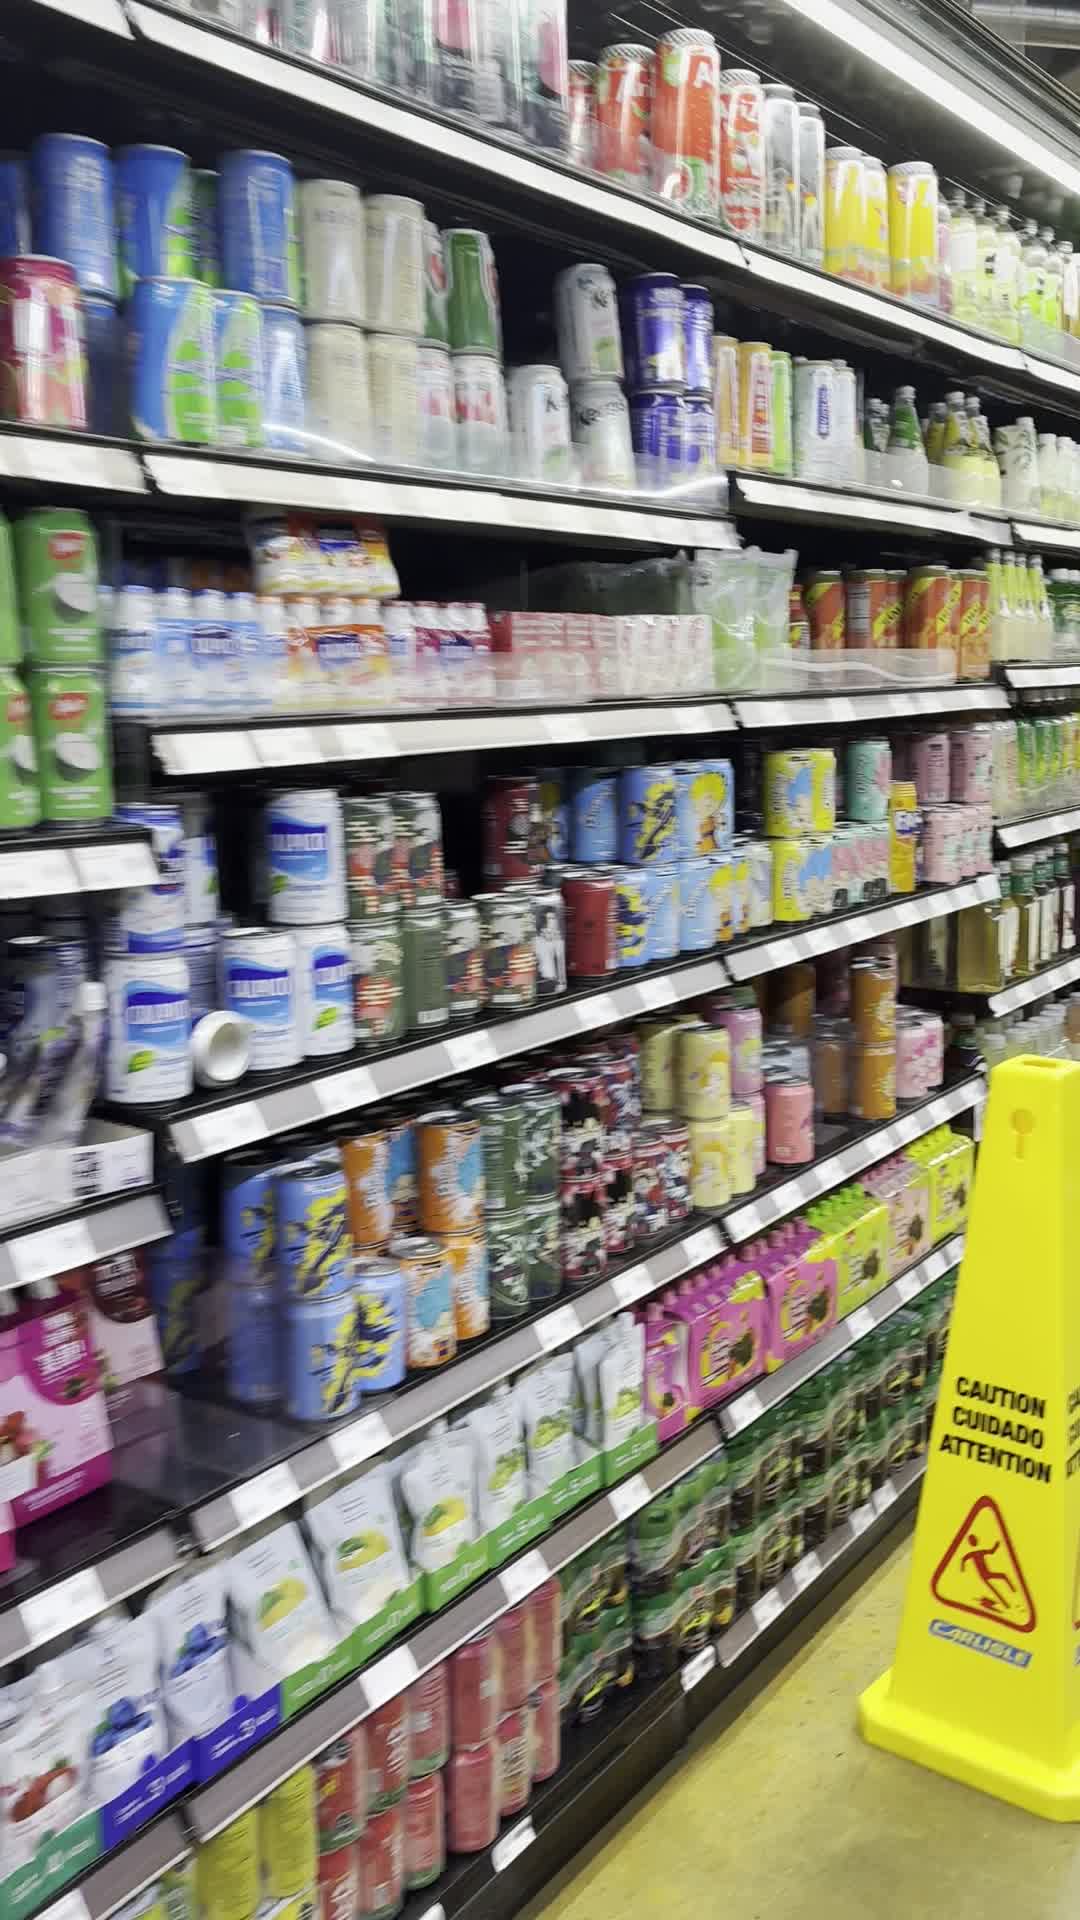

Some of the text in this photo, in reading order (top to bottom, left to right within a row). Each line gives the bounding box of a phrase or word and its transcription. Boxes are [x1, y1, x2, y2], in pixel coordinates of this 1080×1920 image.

[956, 1376, 1045, 1418] CAUTION
[952, 1406, 1044, 1449] CUIDADO
[940, 1434, 1052, 1483] ATTENTION
